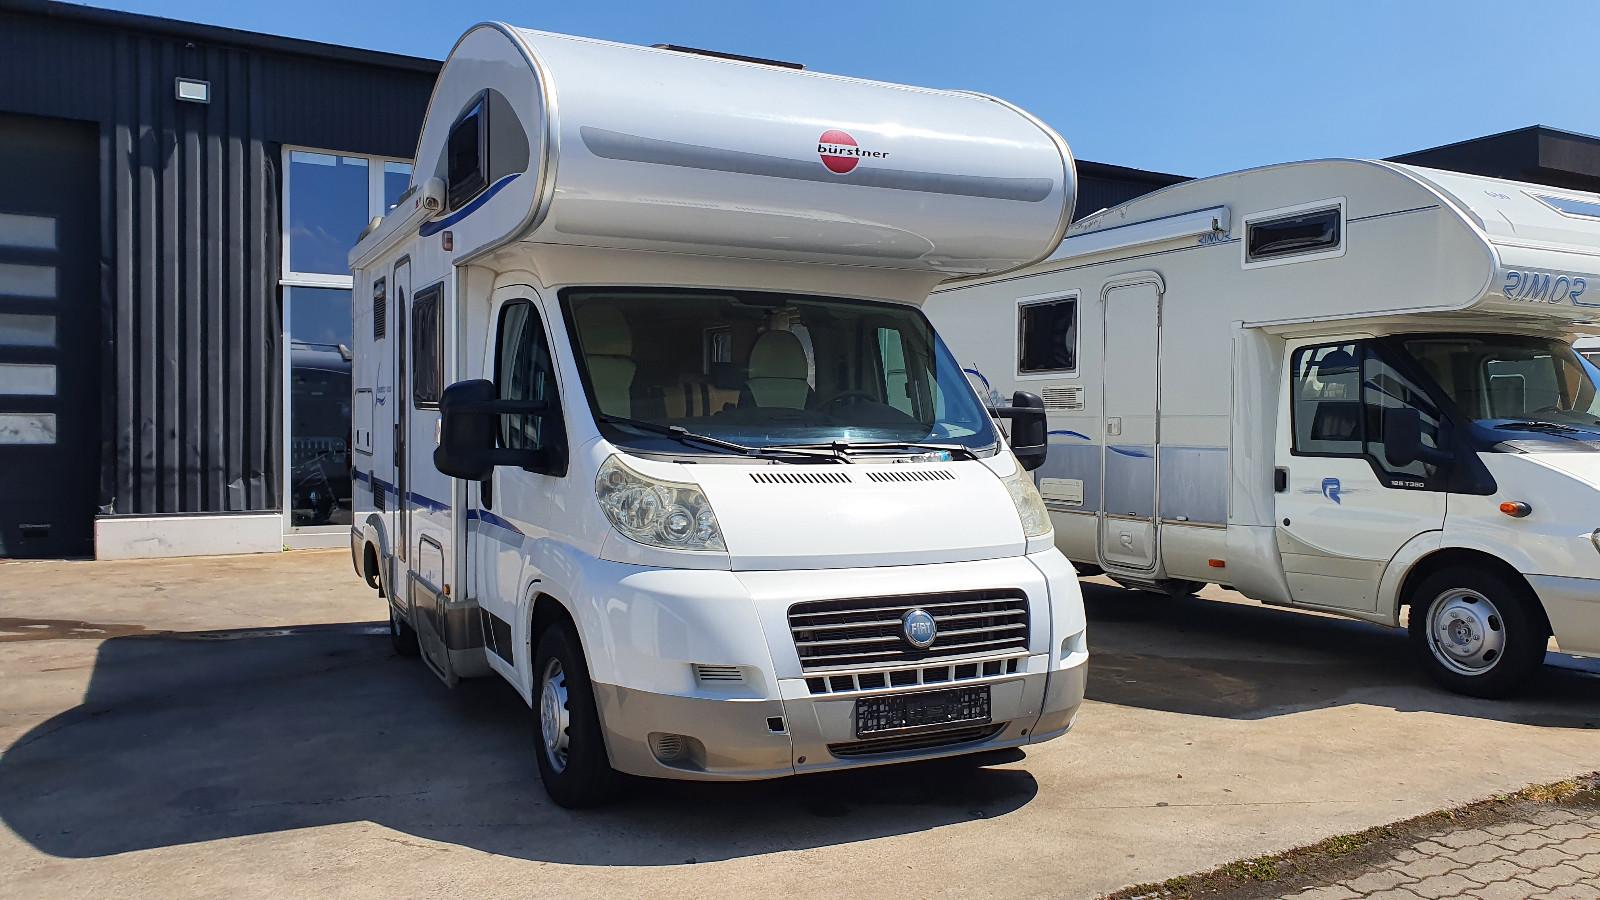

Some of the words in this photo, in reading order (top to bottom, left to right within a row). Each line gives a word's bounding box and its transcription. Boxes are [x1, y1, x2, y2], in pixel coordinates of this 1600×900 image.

[817, 143, 890, 159] bürstner
[1503, 271, 1600, 308] RIMOR
[911, 622, 931, 636] FIAT
